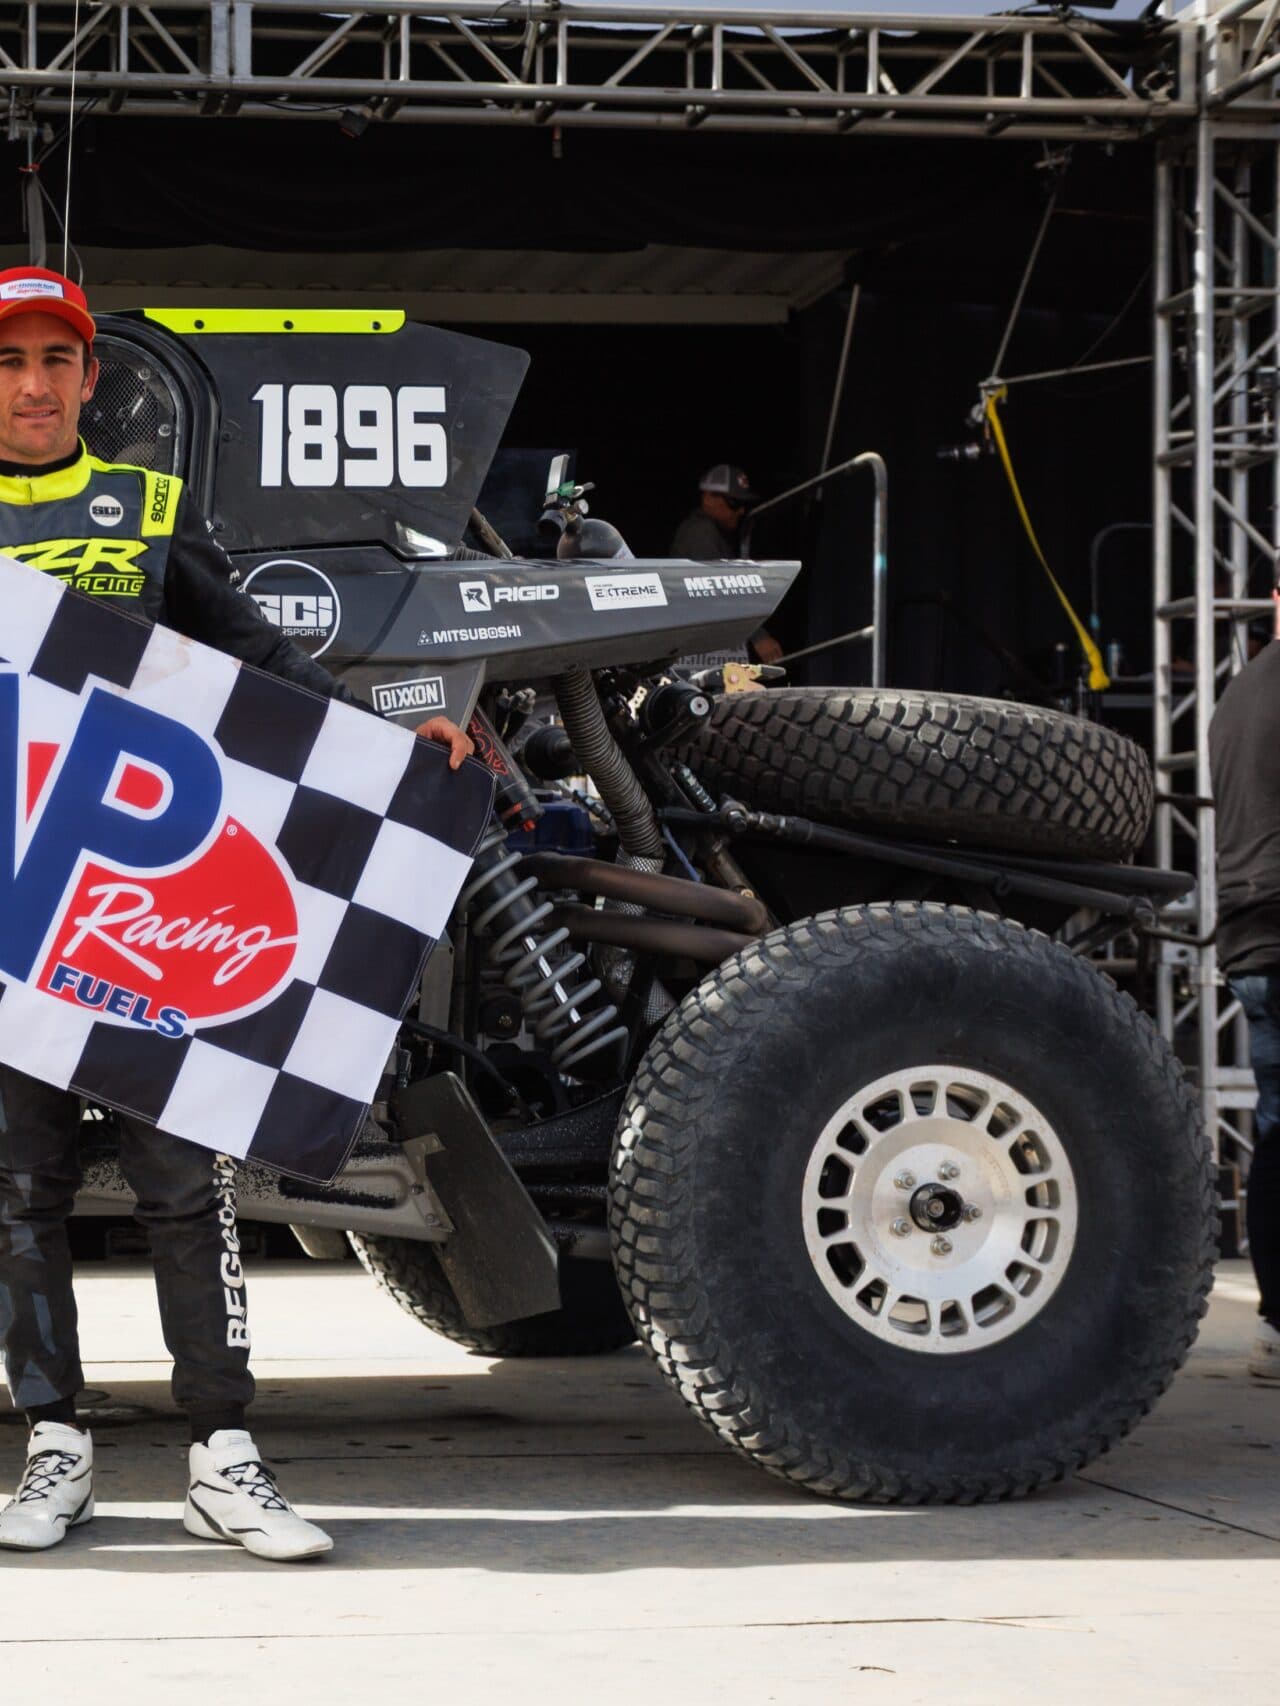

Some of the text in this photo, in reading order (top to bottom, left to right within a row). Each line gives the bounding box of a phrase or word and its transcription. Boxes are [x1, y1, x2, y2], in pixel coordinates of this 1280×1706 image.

[252, 383, 449, 489] 1896
[595, 585, 659, 599] EXTREME
[683, 574, 764, 591] METHOD
[688, 586, 767, 598] RACE WHEELS
[493, 584, 560, 604] RIGID
[433, 624, 522, 644] MITSUBOSHI
[378, 682, 438, 712] DIXXON
[65, 882, 299, 986] Racing
[47, 963, 189, 1039] FUELS
